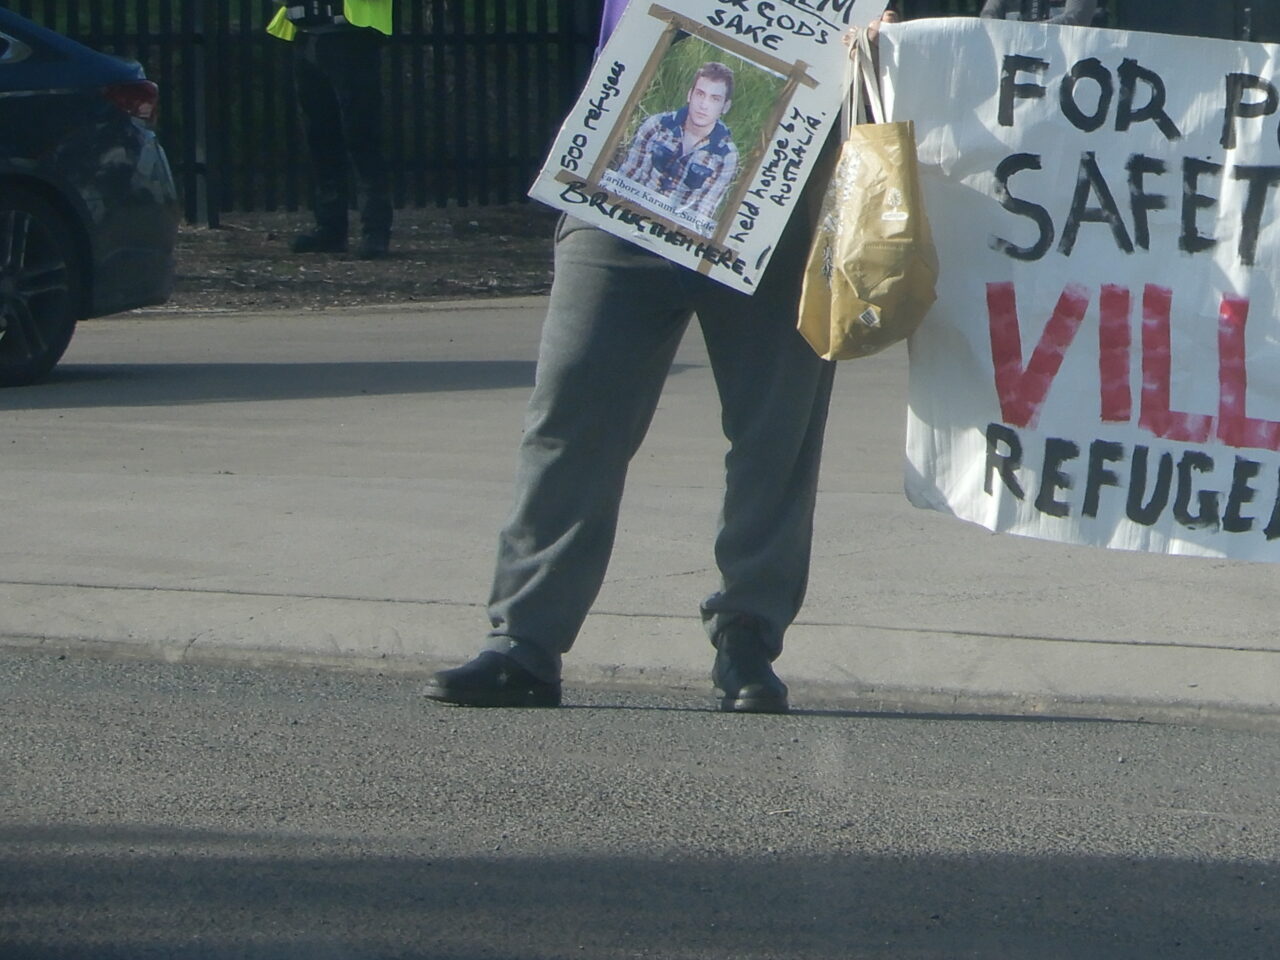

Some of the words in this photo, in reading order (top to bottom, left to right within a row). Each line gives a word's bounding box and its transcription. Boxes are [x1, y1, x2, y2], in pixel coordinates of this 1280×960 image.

[706, 8, 784, 51] SAKE
[757, 2, 830, 45] GOD'S
[997, 54, 1181, 141] FOR
[560, 133, 588, 172] 500
[729, 200, 760, 243] held
[779, 106, 806, 134] by
